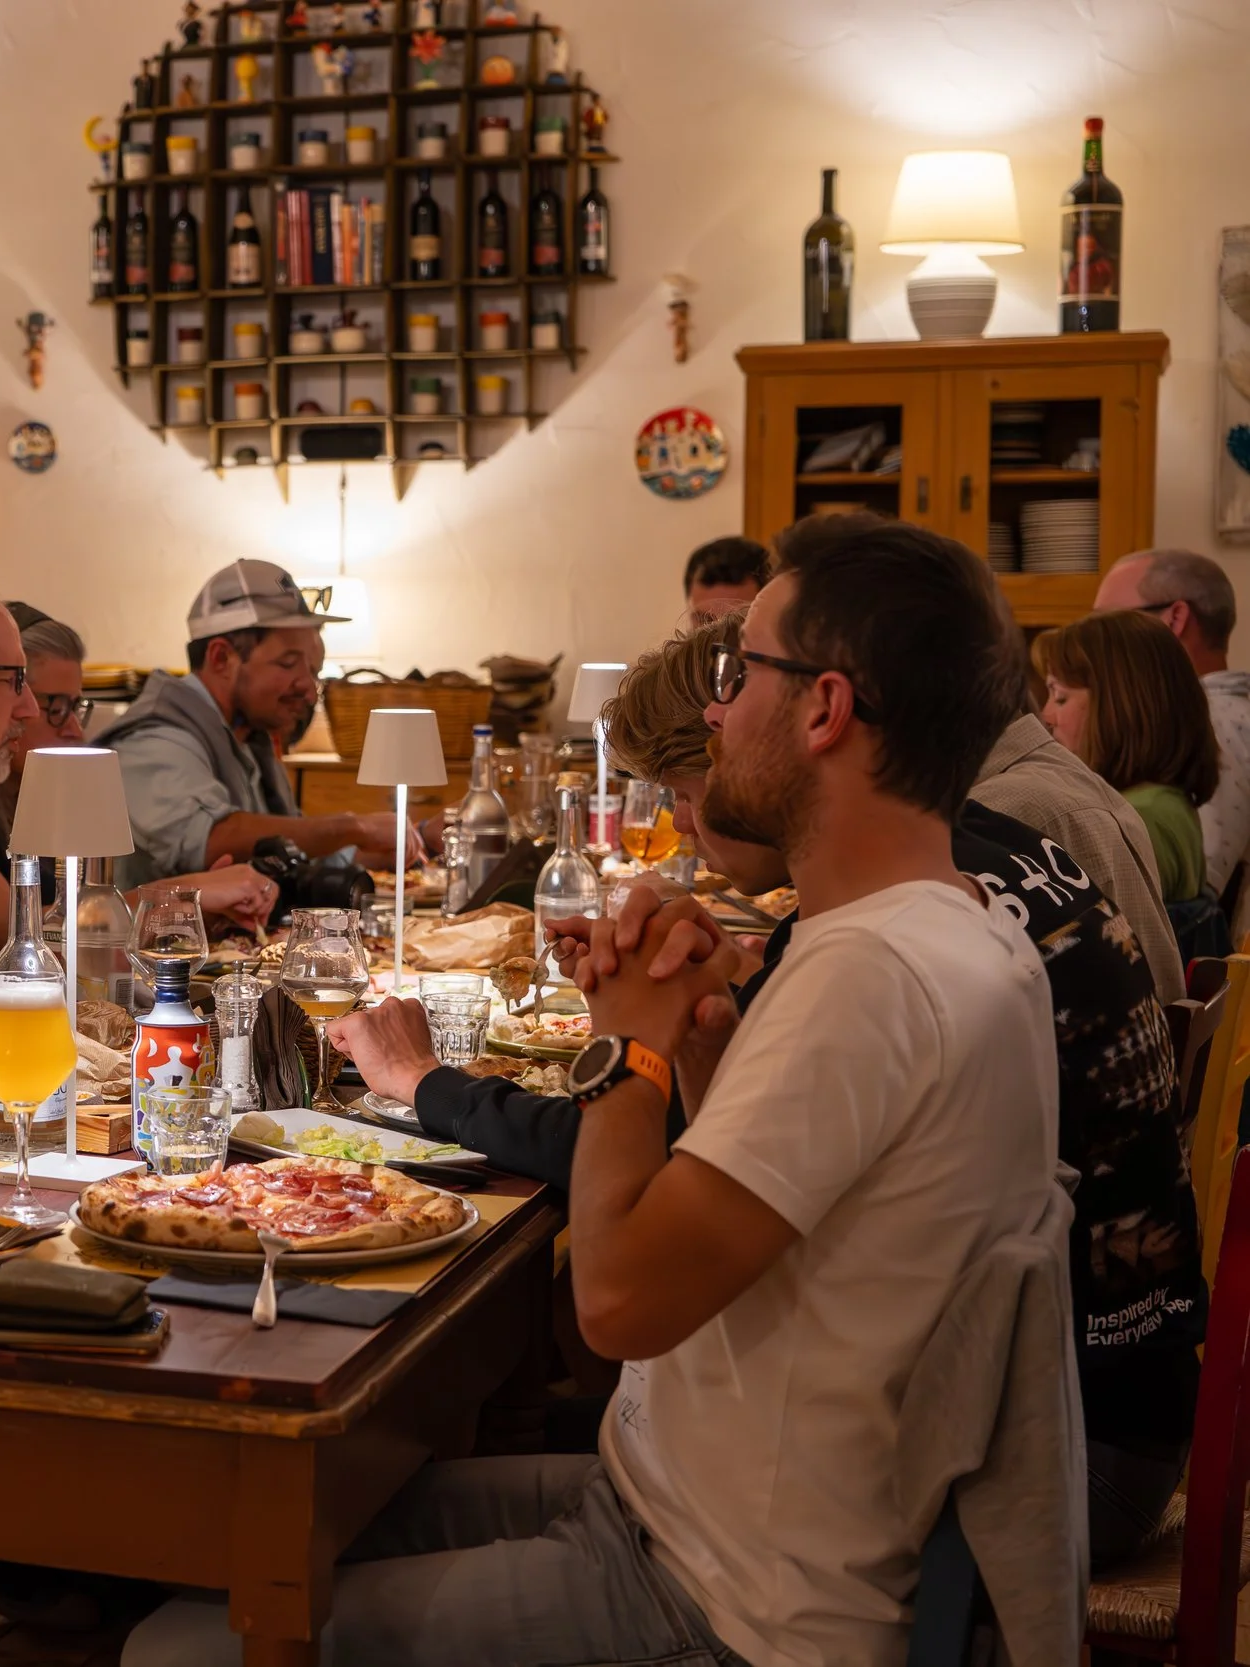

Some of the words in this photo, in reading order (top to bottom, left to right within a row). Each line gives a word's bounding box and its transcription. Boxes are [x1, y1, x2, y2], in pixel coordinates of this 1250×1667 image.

[1086, 1311, 1163, 1346] Everyday
[1087, 1291, 1152, 1331] Inspired
[1154, 1286, 1170, 1306] by
